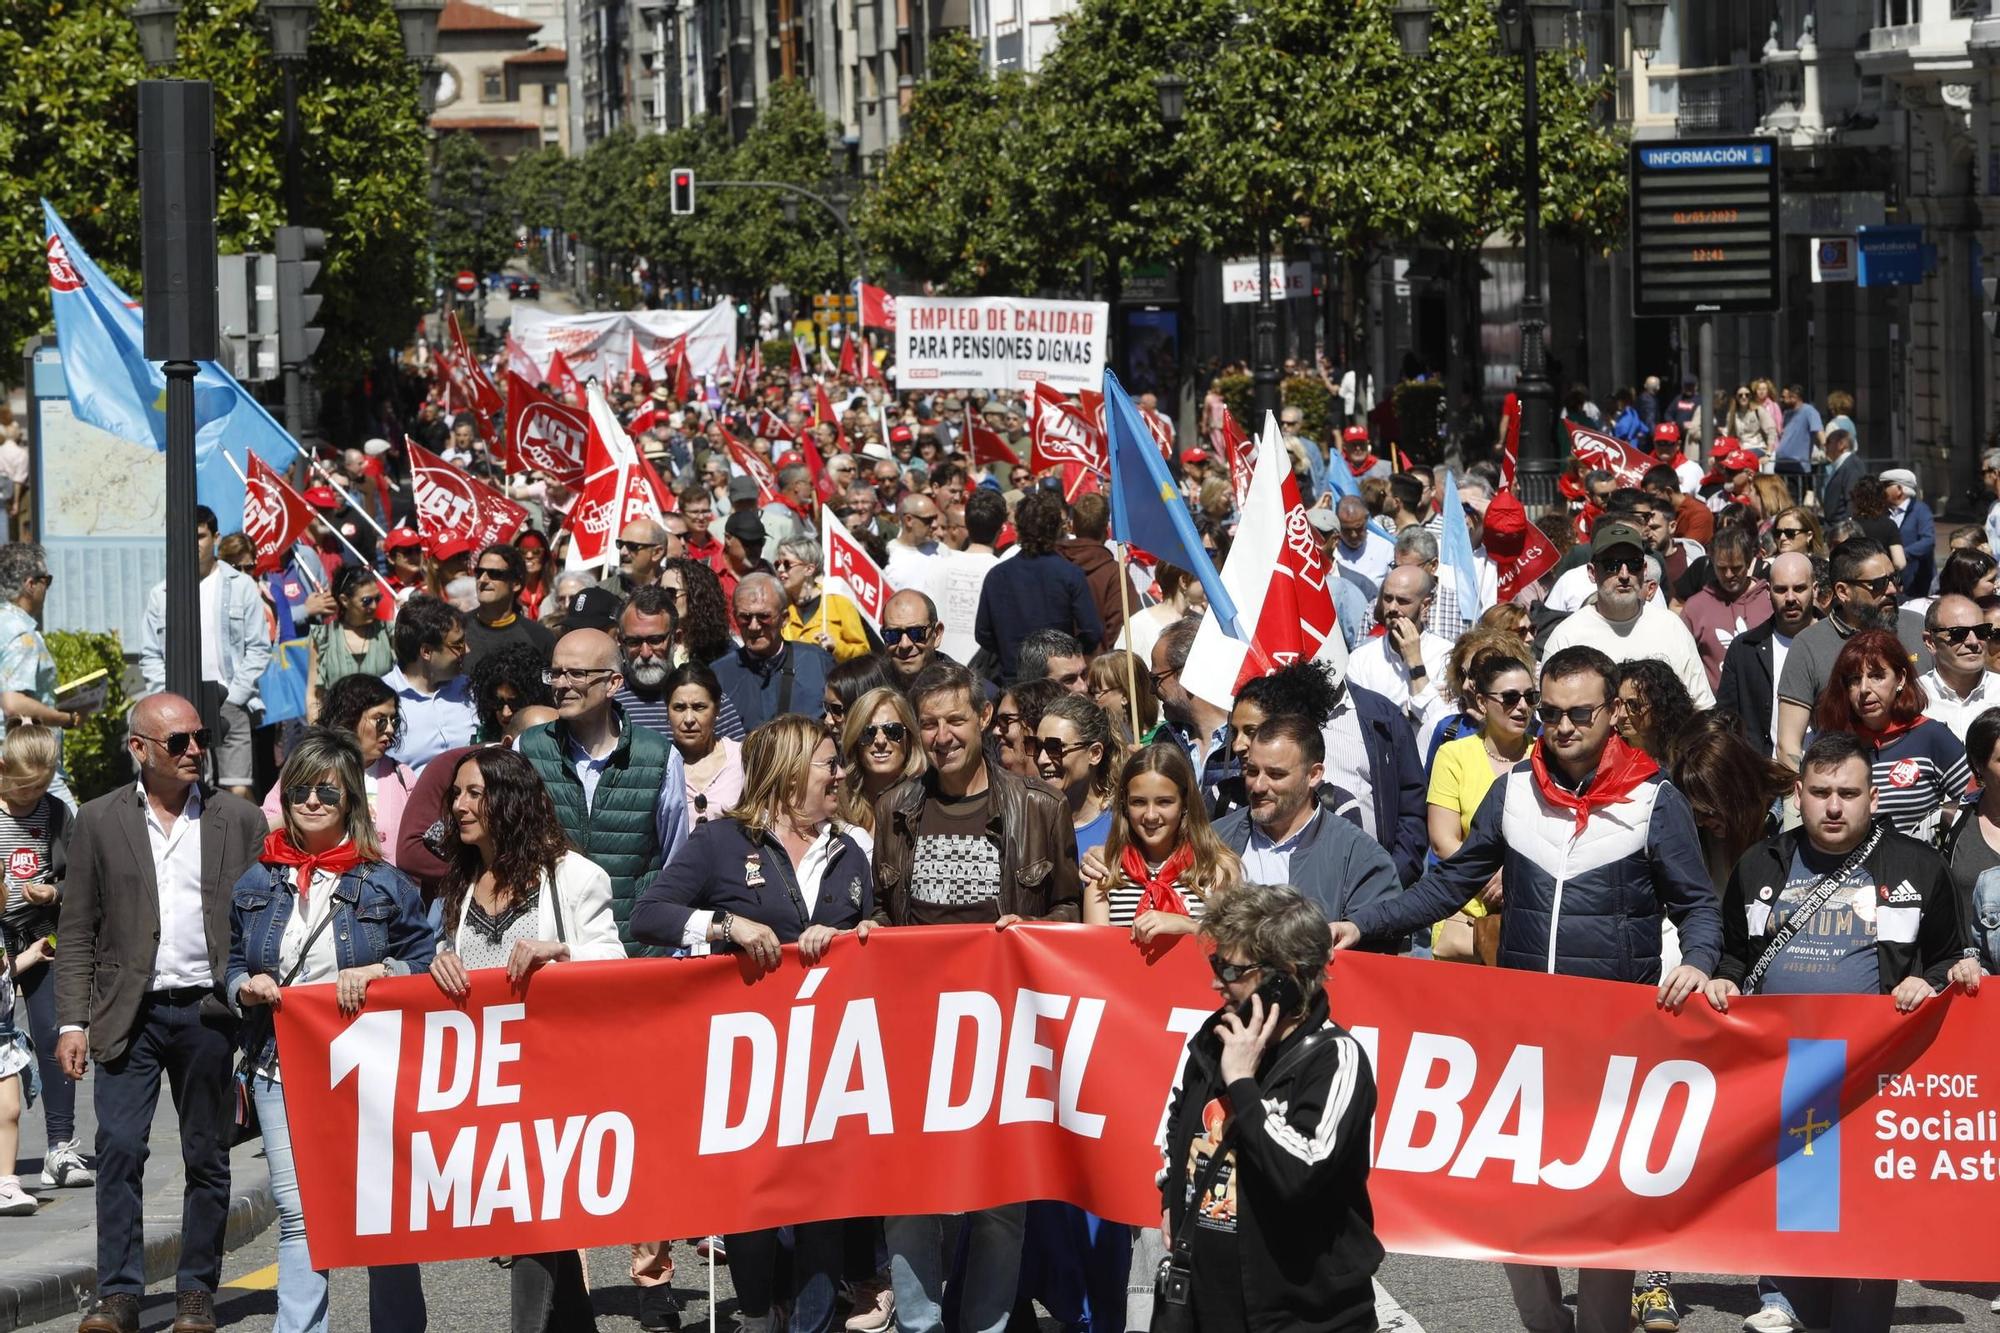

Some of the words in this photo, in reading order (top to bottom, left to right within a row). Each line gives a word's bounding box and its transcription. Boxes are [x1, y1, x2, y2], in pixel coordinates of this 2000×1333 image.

[1649, 147, 1747, 165] INFORMACIÓN
[1672, 210, 1739, 224] 01/05/2023
[1692, 249, 1725, 262] 12:41
[1233, 275, 1304, 293] PAAJE
[910, 307, 978, 330] EMPLEO
[987, 308, 1007, 331] DE
[1015, 309, 1093, 335] CALIDAD
[909, 336, 947, 359] PARA
[953, 337, 1032, 359] PENSIONES
[1037, 339, 1092, 364] DIGNAS
[527, 409, 585, 467] UGT
[629, 477, 652, 495] FS
[413, 473, 471, 528] UGT
[12, 852, 35, 866] UGT
[1816, 878, 1840, 900] 1980
[1889, 893, 1922, 902] adidas
[1833, 948, 1847, 956] NY
[698, 966, 894, 1155] DÍA
[922, 987, 1107, 1139] DEL
[1153, 1006, 1717, 1197] TBAJO
[1877, 1073, 1979, 1098] FSA-PSOE
[330, 1009, 402, 1236] 1
[417, 1002, 526, 1113] DE
[409, 1110, 635, 1232] MAYO
[1874, 1148, 1917, 1180] de
[1930, 1149, 2000, 1181] Ast
